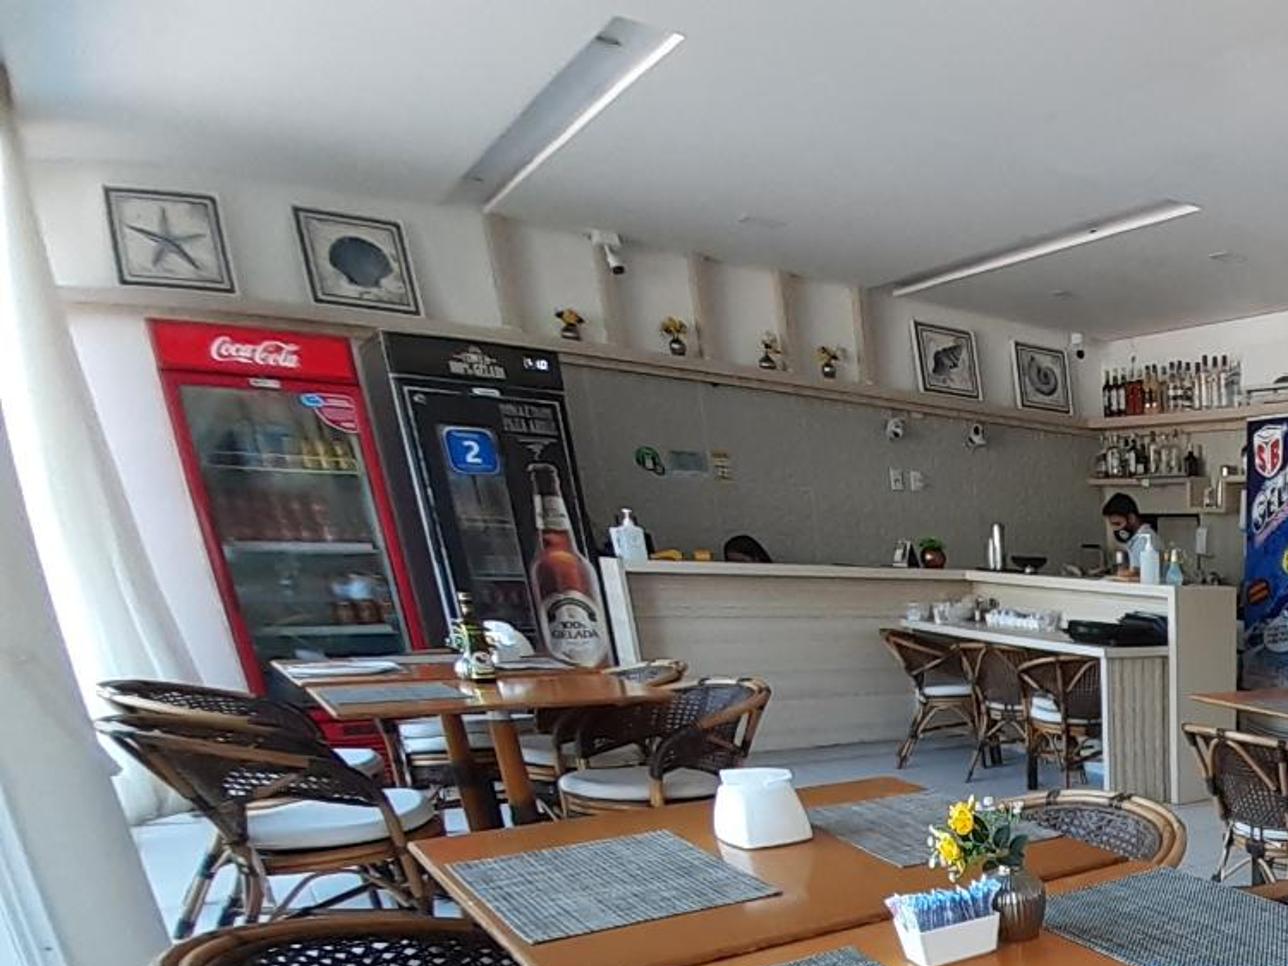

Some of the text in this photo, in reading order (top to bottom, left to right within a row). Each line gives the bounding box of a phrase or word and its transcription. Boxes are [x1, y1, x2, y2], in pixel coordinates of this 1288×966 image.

[210, 335, 300, 368] Coca-Cola
[462, 440, 483, 464] 2
[551, 629, 600, 641] GELADA
